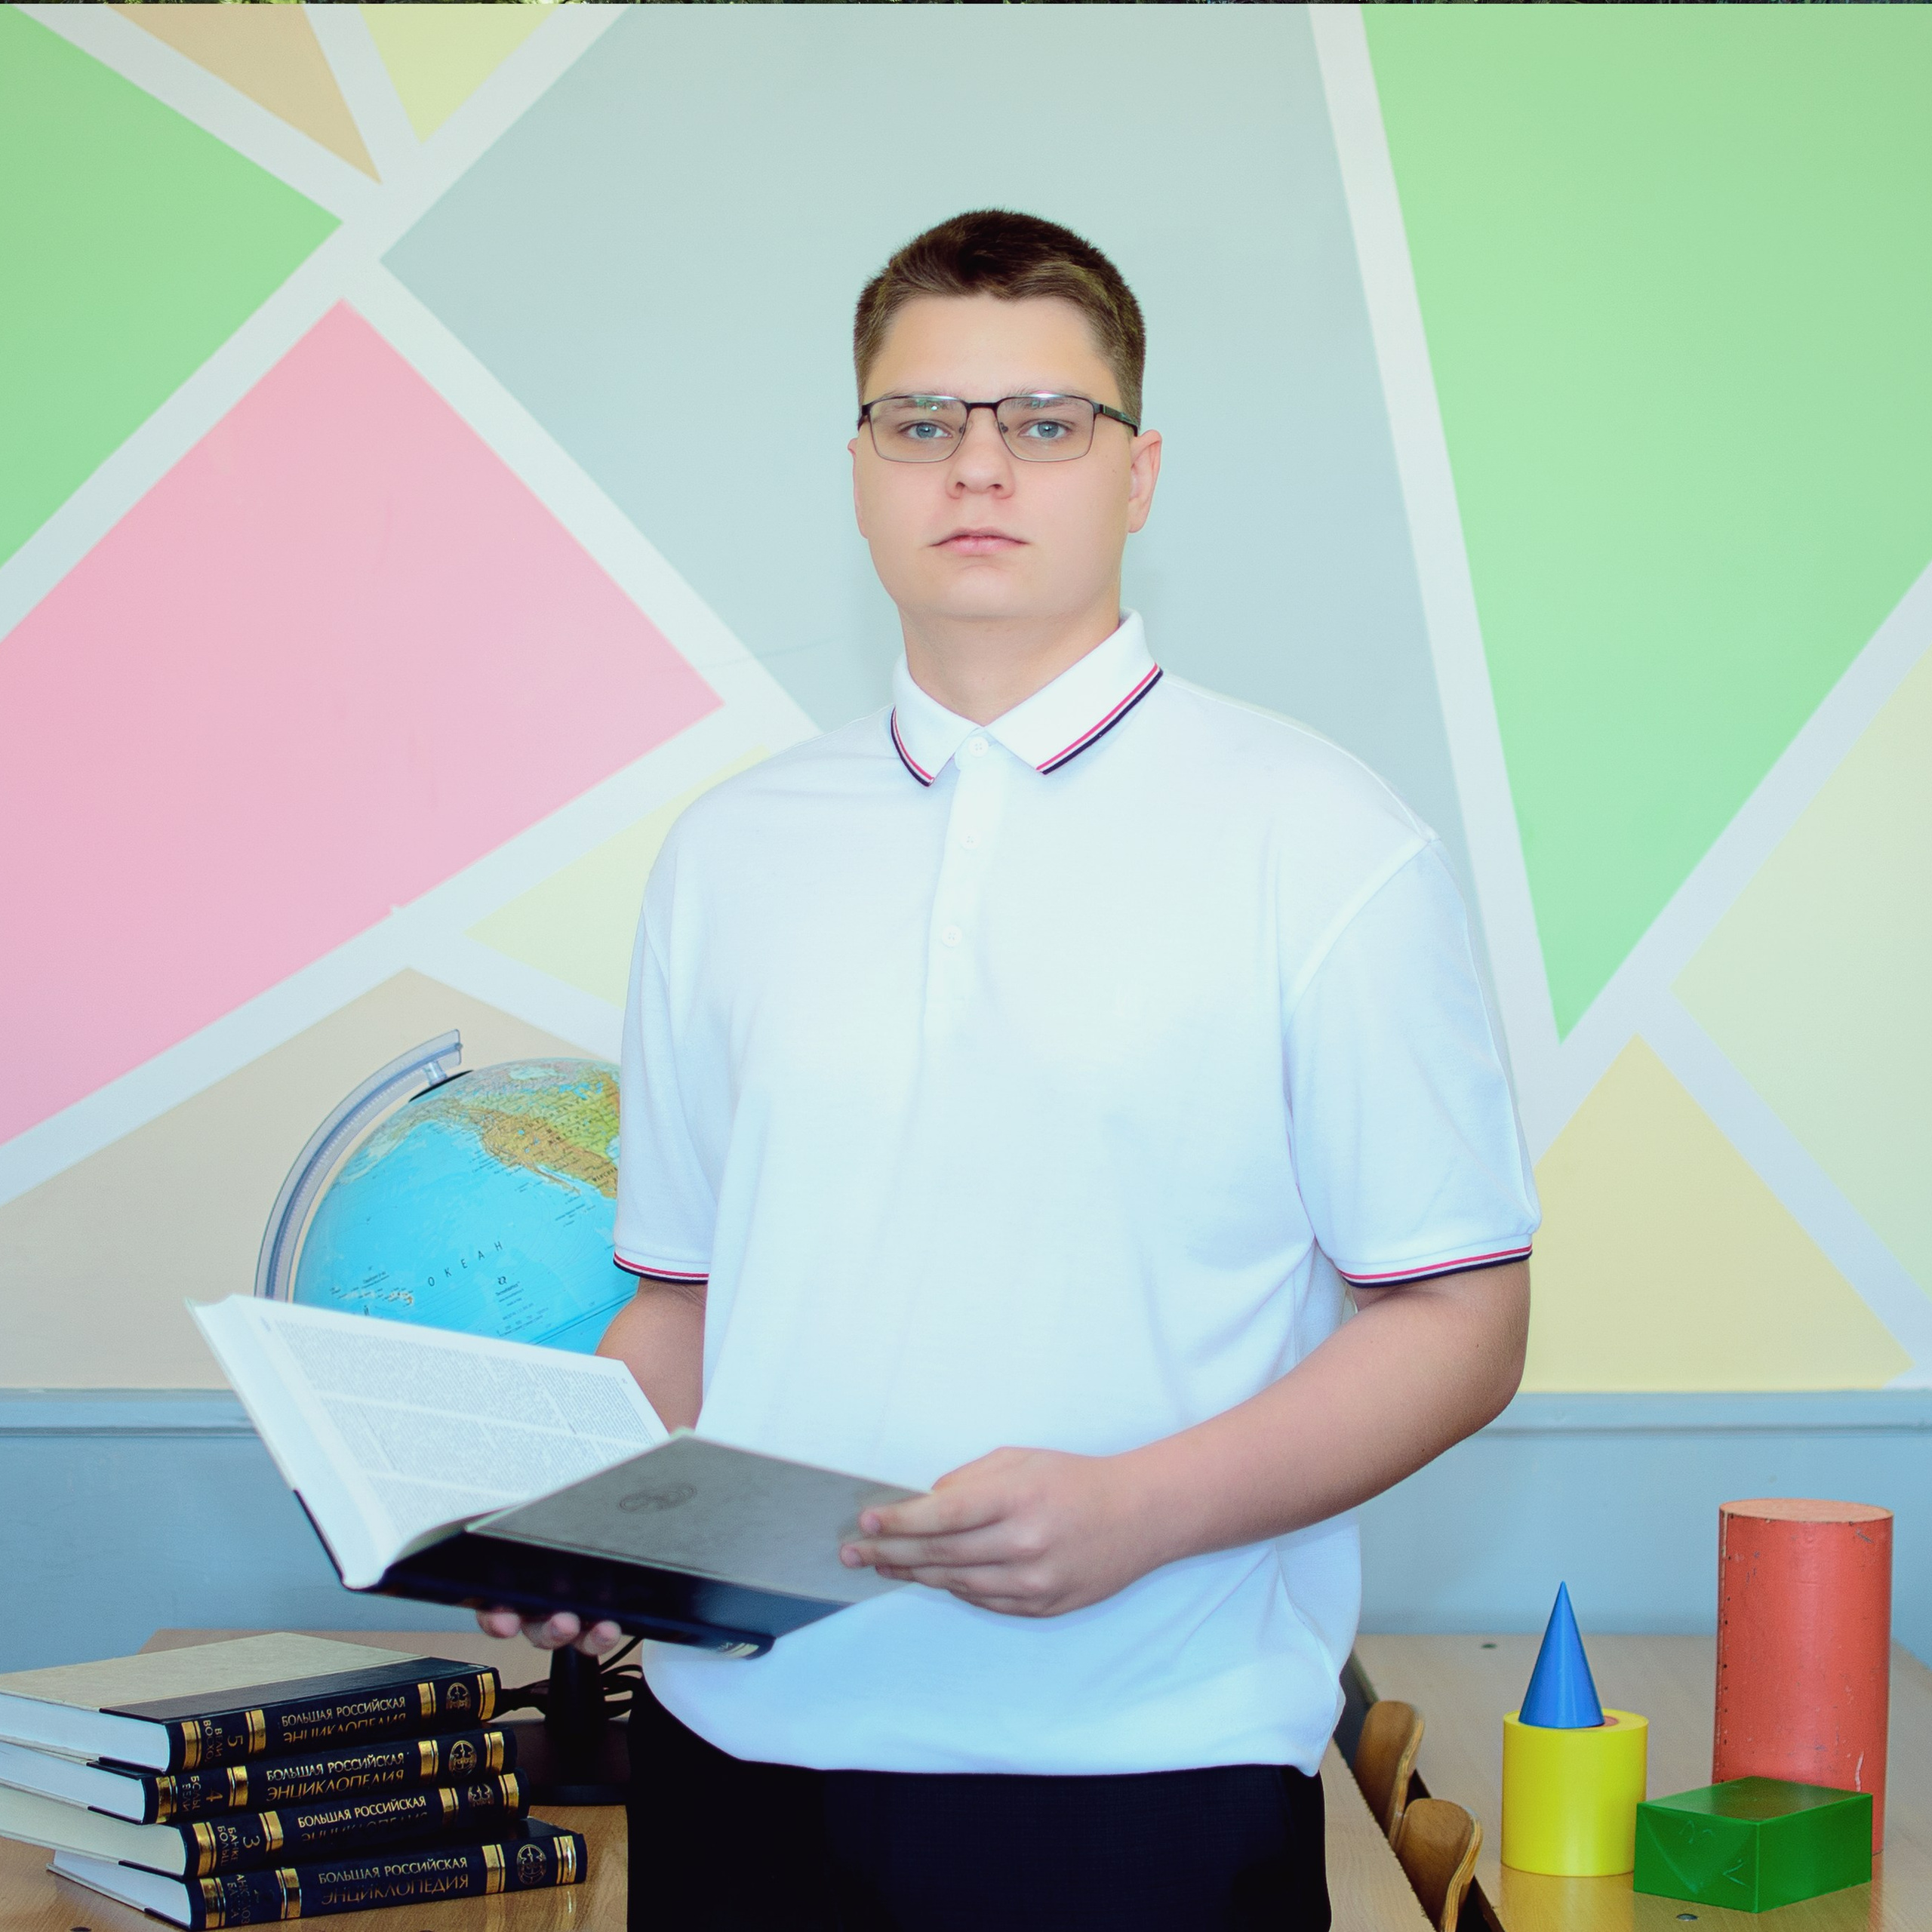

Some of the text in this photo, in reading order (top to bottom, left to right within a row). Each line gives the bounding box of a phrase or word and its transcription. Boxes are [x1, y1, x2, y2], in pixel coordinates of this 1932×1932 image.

[428, 1241, 503, 1287] ОКЕАН
[281, 1697, 406, 1727] БОЛЬШАЯ РОССИЙСКАЯ
[227, 1735, 244, 1747] 5
[266, 1752, 405, 1782] БОЛЬШАЯ РОССИЙСКАЯ
[205, 1789, 223, 1802] 4
[297, 1809, 352, 1829] БОЛЬШАЯ
[355, 1795, 426, 1818] РОССИЙСКАЯ
[243, 1835, 260, 1849] 3
[318, 1857, 468, 1884] БОЛЬШАЯ РОССИЙСКАЯ
[321, 1873, 469, 1905] ЭНЦИКЛОПЕДИЯ
